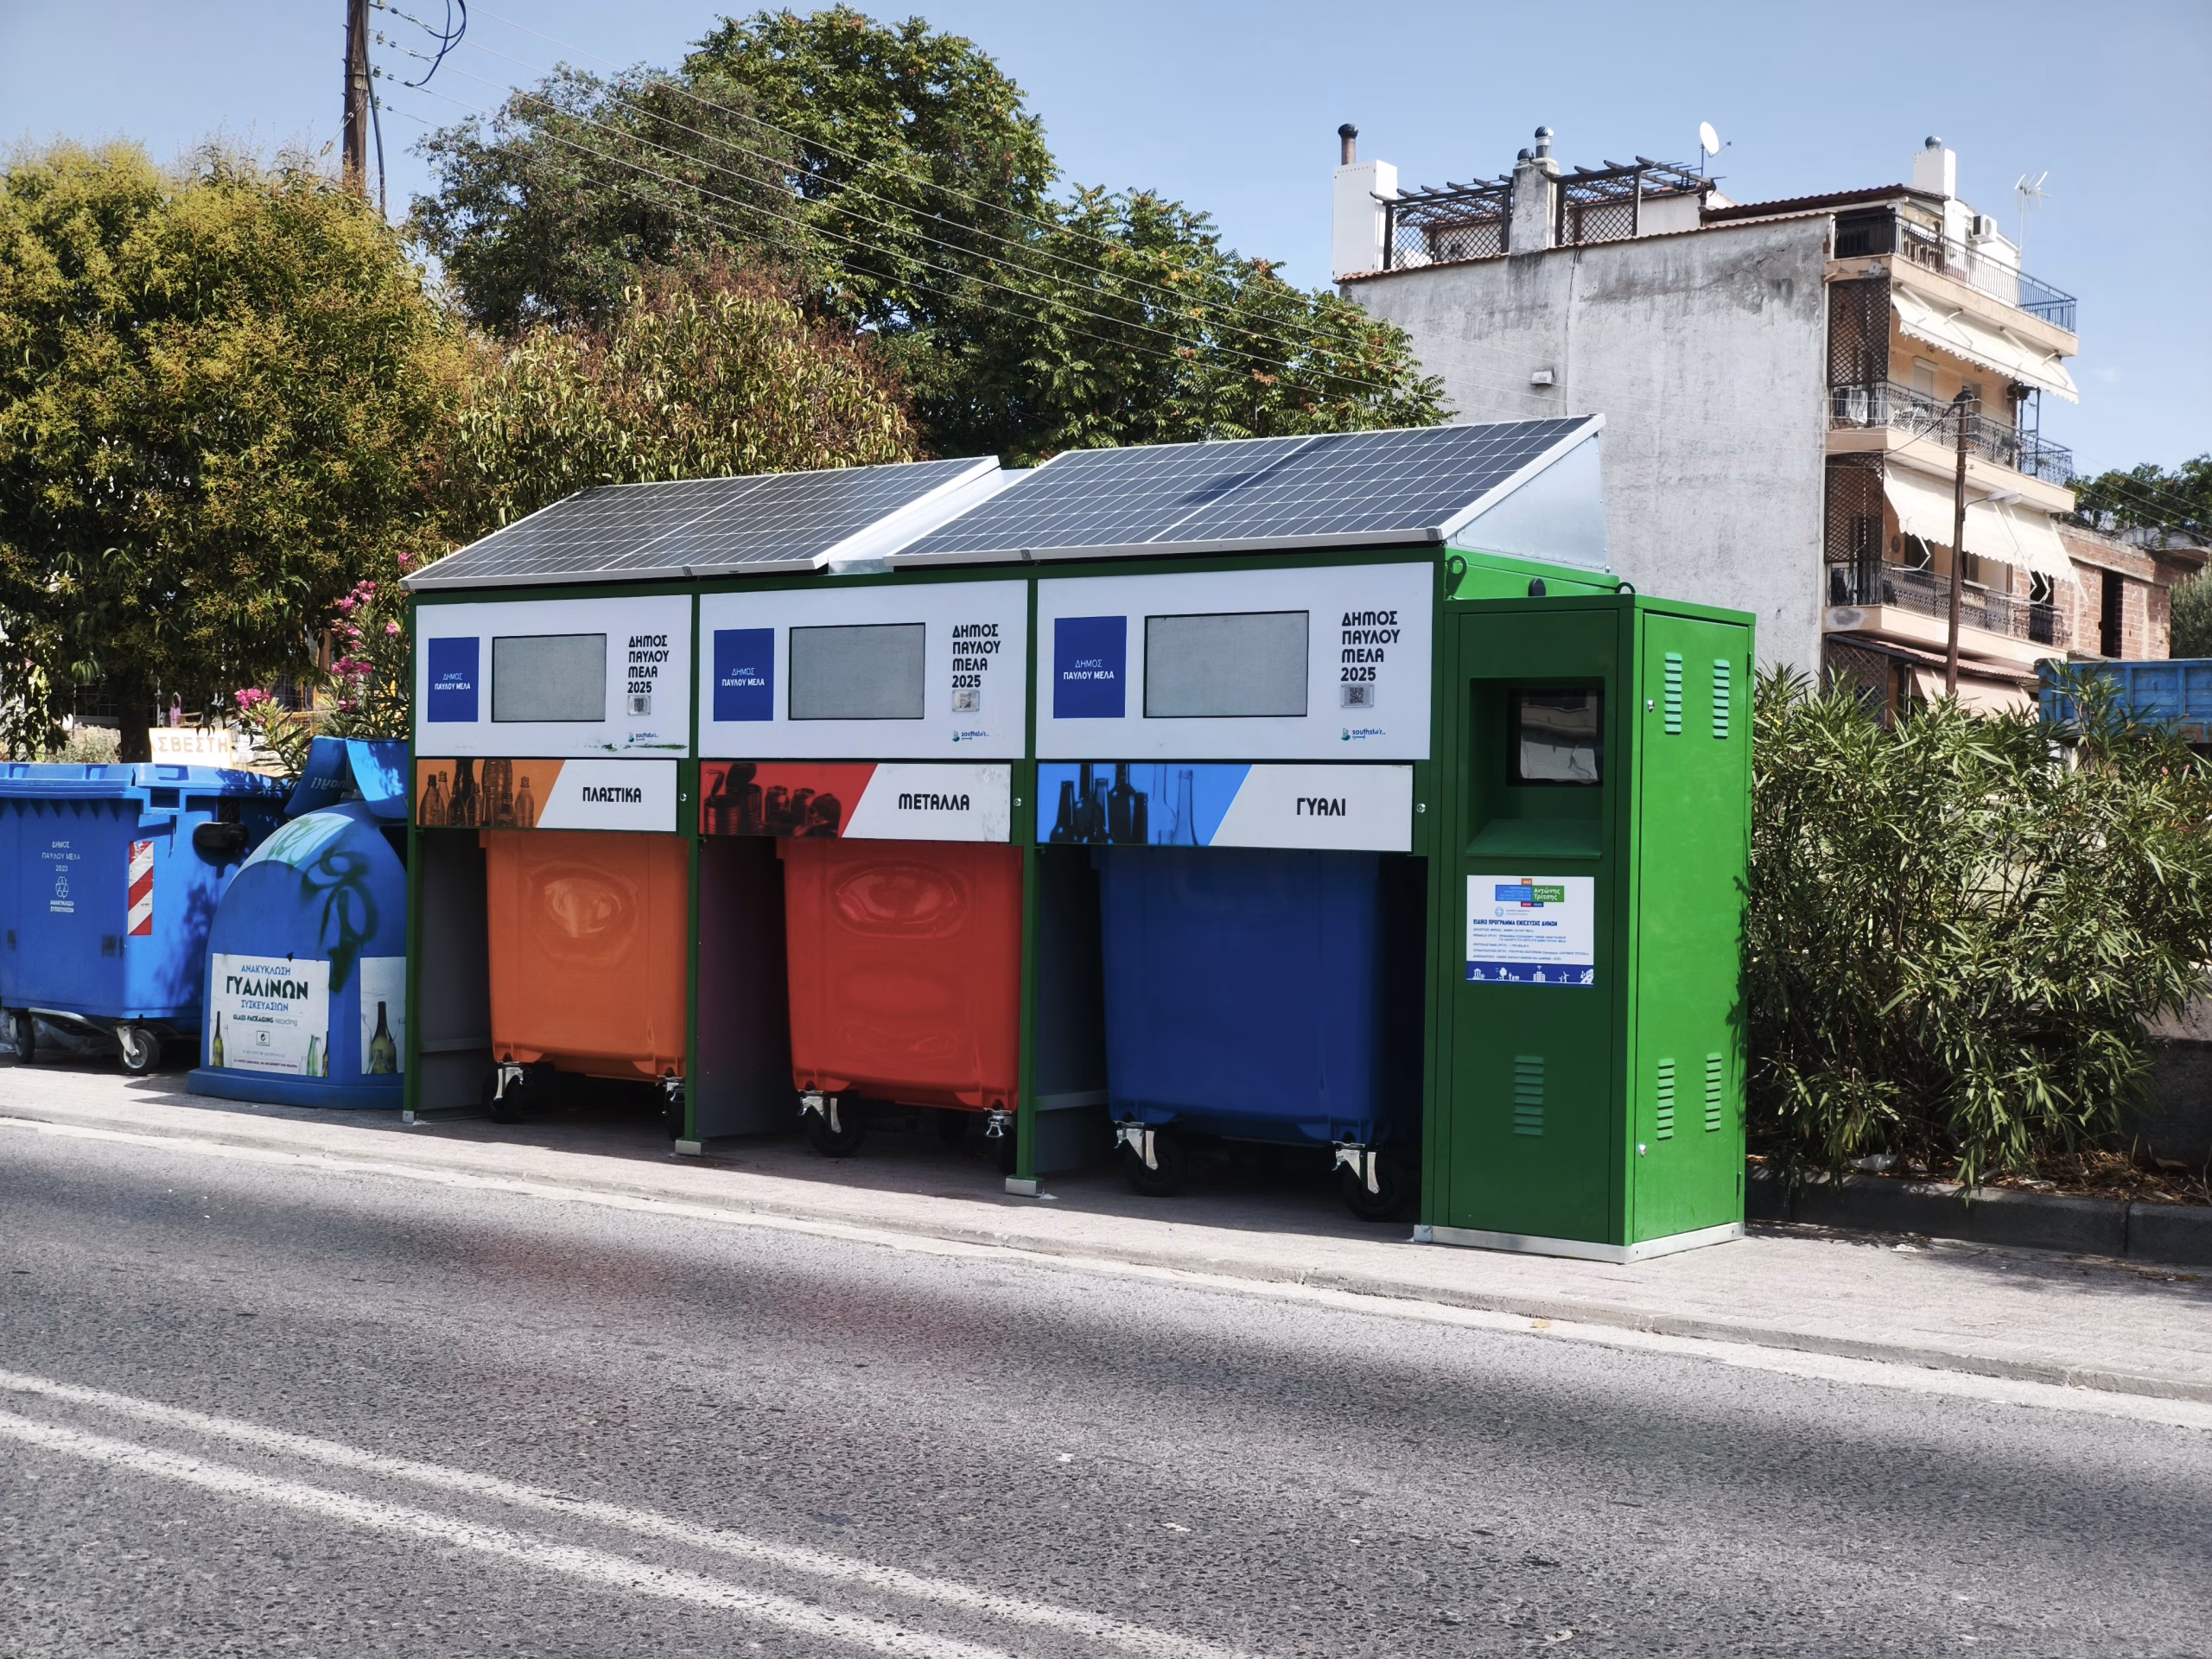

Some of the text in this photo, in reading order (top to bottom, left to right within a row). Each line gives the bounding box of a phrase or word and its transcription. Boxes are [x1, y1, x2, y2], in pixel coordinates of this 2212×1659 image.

[1341, 610, 1398, 626] ΔΗΜΟΣ
[952, 624, 999, 638] ΔΗΜΟΣ
[1342, 629, 1401, 645] ΠΑΥΛΟΥ
[628, 635, 668, 648] ΔΗΜΟΣ
[952, 640, 1001, 654] ΠΑΥΛΟΥ
[628, 650, 670, 663] ΠΑΥΛΟΥ
[1341, 648, 1384, 663] ΜΕΛΑ
[952, 658, 988, 671] ΜΕΛΑ
[1075, 658, 1103, 668] ΔΗΜΟΣ
[442, 672, 463, 681] ΔΗΜΟΣ
[628, 665, 658, 678] ΜΕΛΑ
[732, 667, 755, 676] ΔΗΜΟΣ
[1063, 671, 1115, 680] ΠΑΥΛΟΥ ΜΕΛΑ
[1340, 666, 1376, 682] 2025
[455, 682, 471, 690] ΜΕΛΑ
[627, 681, 652, 693] 2025
[721, 678, 747, 687] ΠΑΥΛΟΥ
[951, 675, 982, 688] 2025
[150, 736, 229, 753] ΣΒΕΣΤΗ
[582, 786, 642, 804] ΠΛΑΣΤΙΚΑ
[899, 792, 969, 810] ΜΕΤΑΛΛΑ
[1296, 798, 1346, 817] ΓΥΑΛΙ
[66, 852, 81, 861] ΜΕΛΑ
[241, 964, 291, 976] ΑΝΑΚΥΚΛΩΣΗ
[226, 976, 308, 1000] ΓΥΑΛΙΝΩΝ
[241, 999, 289, 1012] ΣΥΣΚΕΥΑΣΙΩΝ
[246, 1015, 274, 1024] PACKAGING
[275, 1018, 298, 1027] recycling
